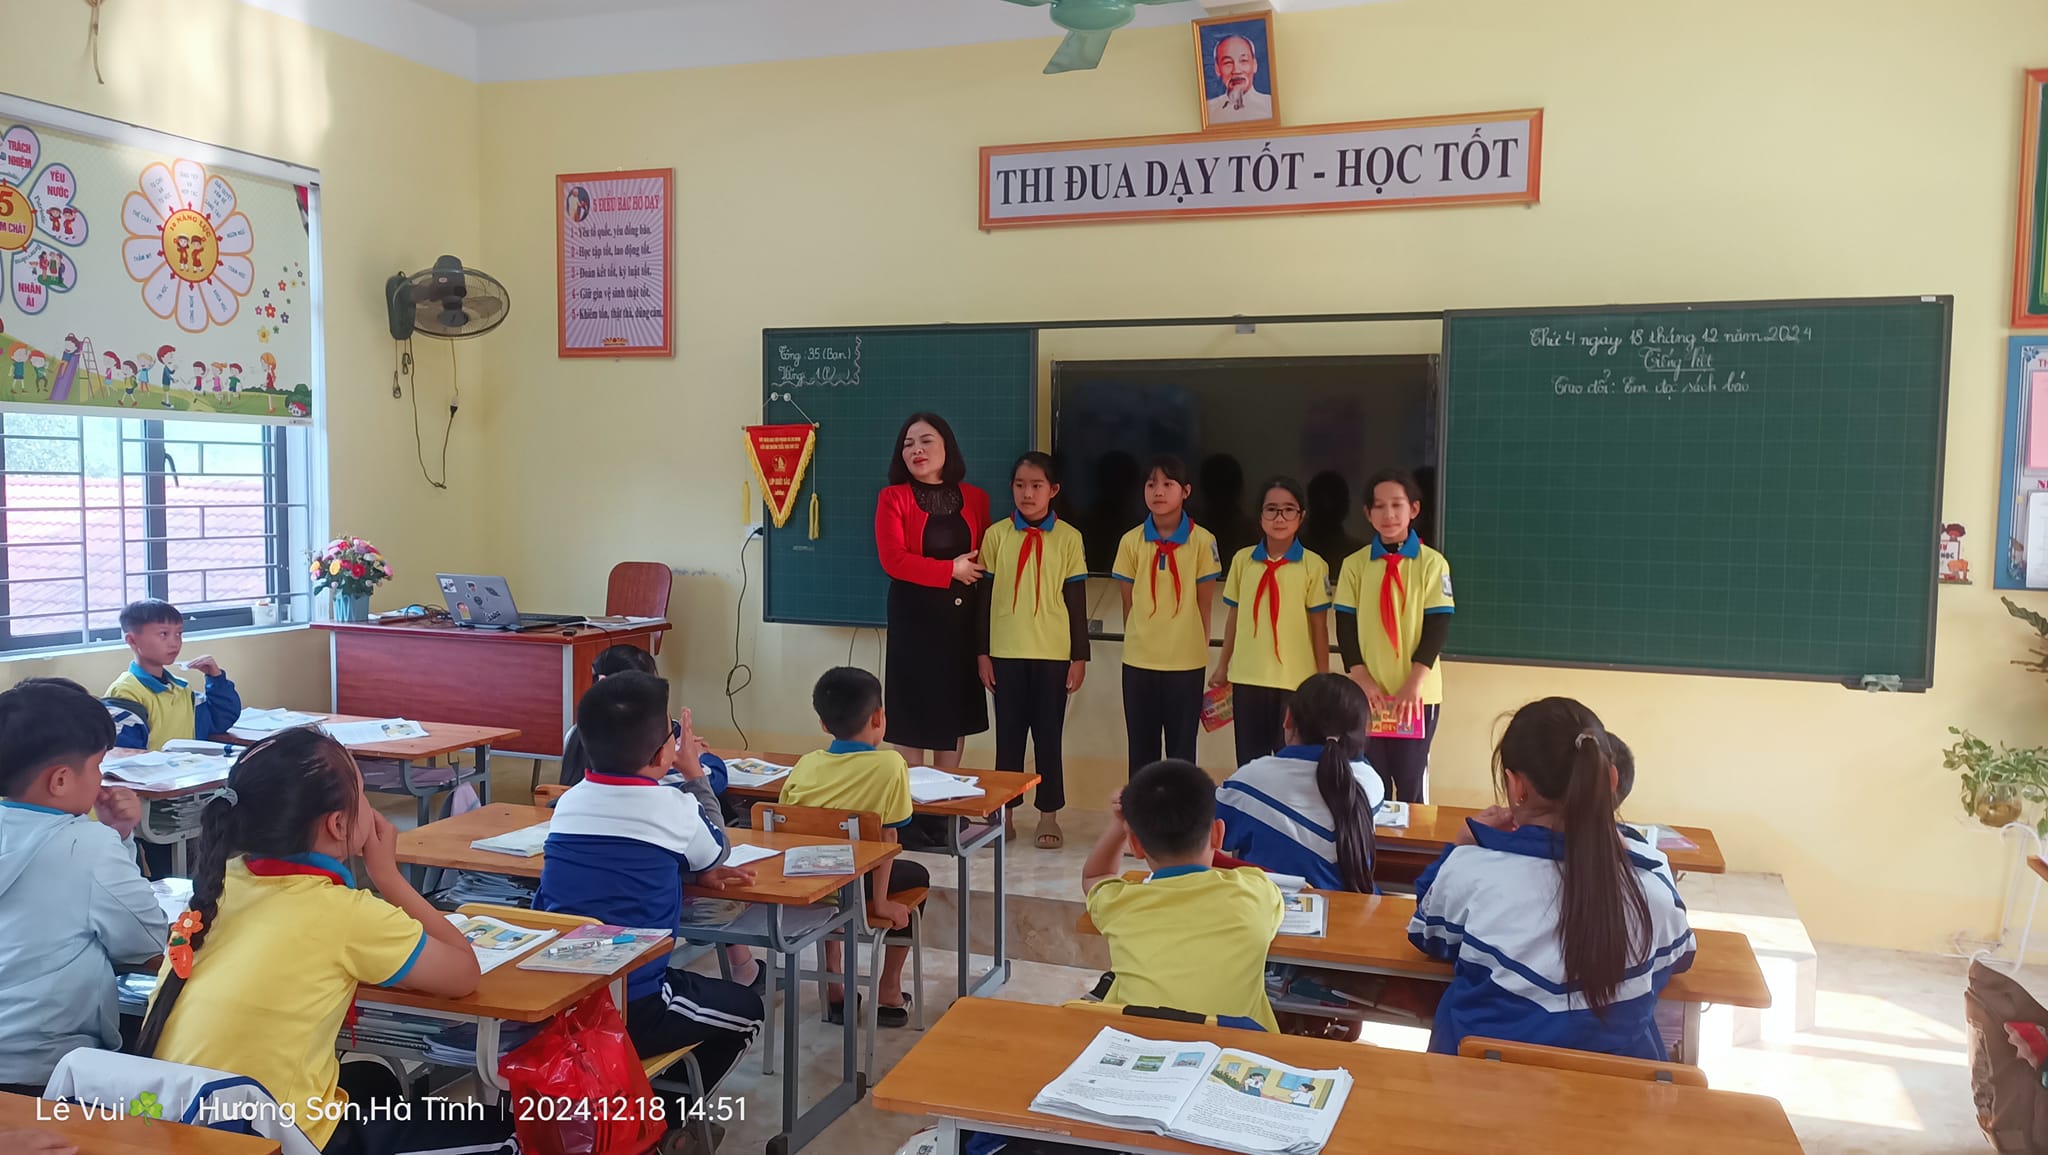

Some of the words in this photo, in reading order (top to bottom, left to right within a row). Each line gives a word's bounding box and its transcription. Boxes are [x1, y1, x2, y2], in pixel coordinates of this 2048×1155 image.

[7, 139, 32, 154] TRÁCH
[7, 154, 32, 170] NHIỆM
[996, 166, 1055, 206] THI
[1064, 160, 1138, 201] ĐUA
[1146, 155, 1222, 204] DẠY
[1228, 141, 1305, 194] TỐT
[1336, 143, 1424, 195] HỌC
[1433, 127, 1520, 183] TỐT
[50, 169, 66, 184] YÊU
[47, 184, 70, 199] NƯỚC
[0, 190, 13, 217] 5
[644, 194, 659, 213] DẠY
[8, 221, 26, 235] CHẤT
[18, 281, 42, 295] NHÂN
[26, 295, 35, 307] ÁI
[1530, 326, 1561, 347] Thứ
[1565, 330, 1576, 346] 4
[1579, 327, 1623, 357] ngày
[1629, 328, 1644, 346] 18
[1648, 326, 1697, 351] tháng
[1702, 327, 1719, 343] 12
[1723, 328, 1762, 343] năm
[1763, 324, 1812, 344] 2024
[807, 347, 821, 360] 35
[1638, 346, 1683, 382] Tiếng
[1622, 375, 1648, 395] Em
